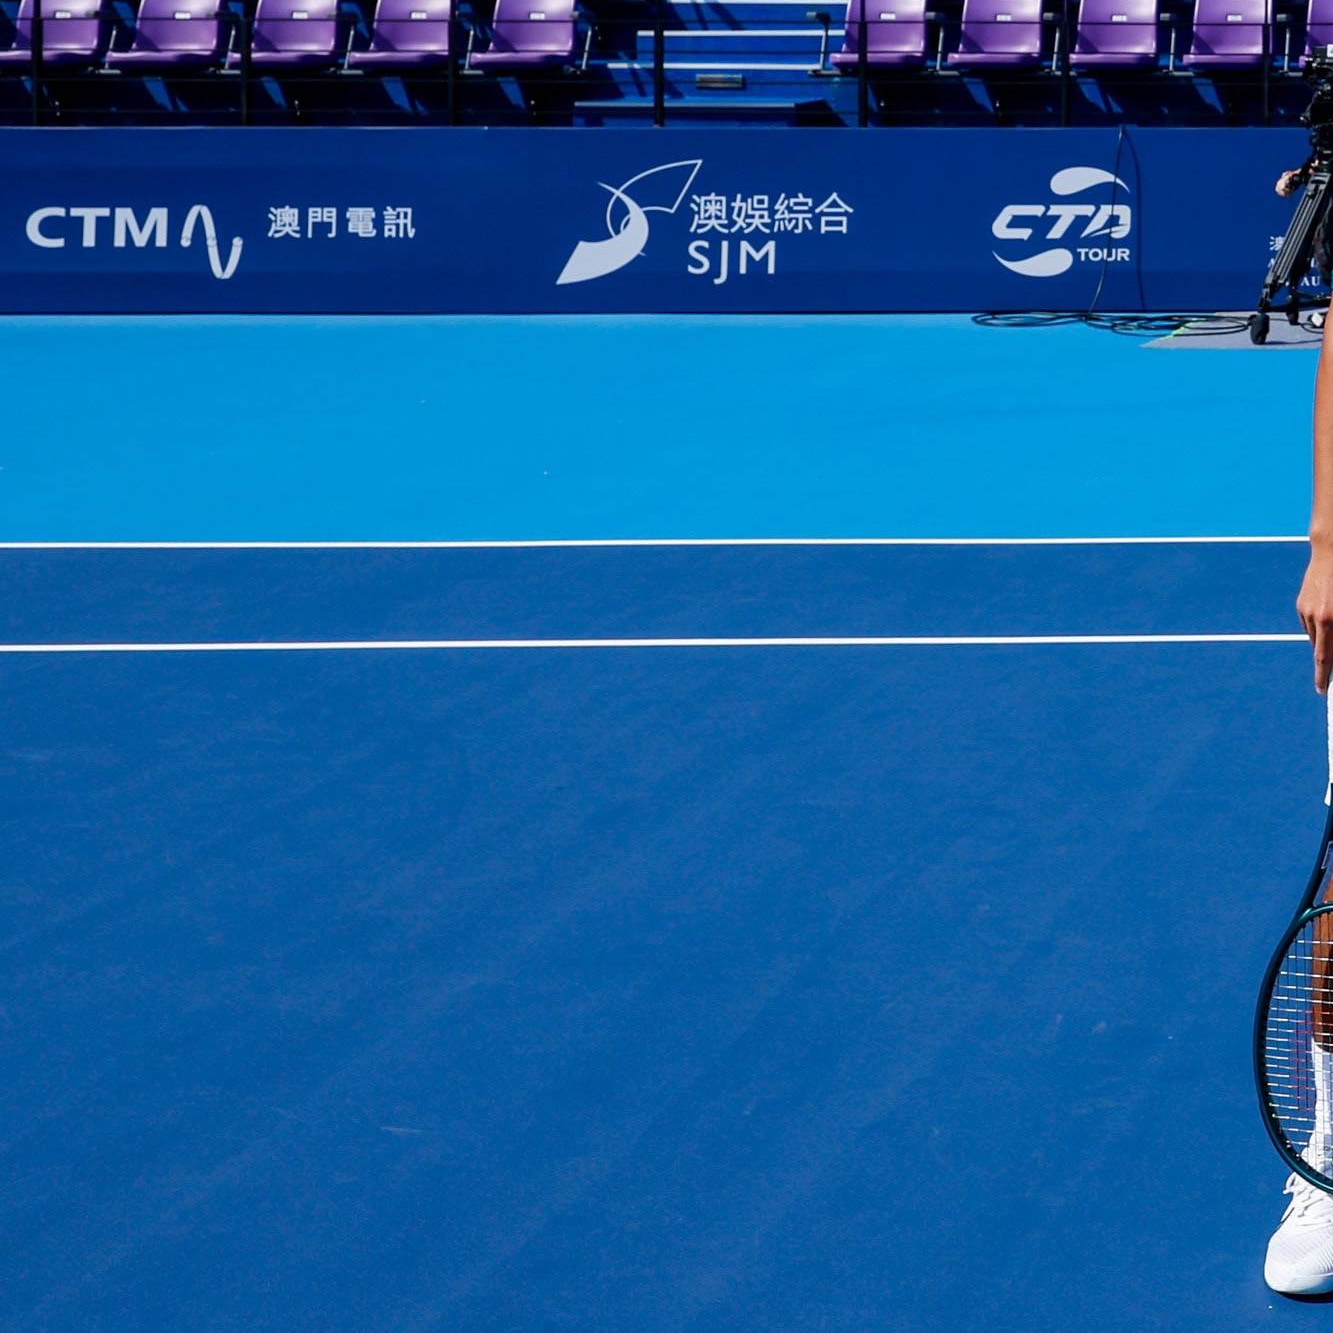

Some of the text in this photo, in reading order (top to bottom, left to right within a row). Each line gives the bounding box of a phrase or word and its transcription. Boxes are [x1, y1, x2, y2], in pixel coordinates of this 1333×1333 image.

[26, 207, 168, 248] CTM
[267, 205, 416, 239] 澳門電訊
[690, 192, 854, 235] 澳娛綜合
[992, 204, 1132, 241] CTA
[687, 239, 776, 285] SJM
[1076, 247, 1131, 262] TOUR
